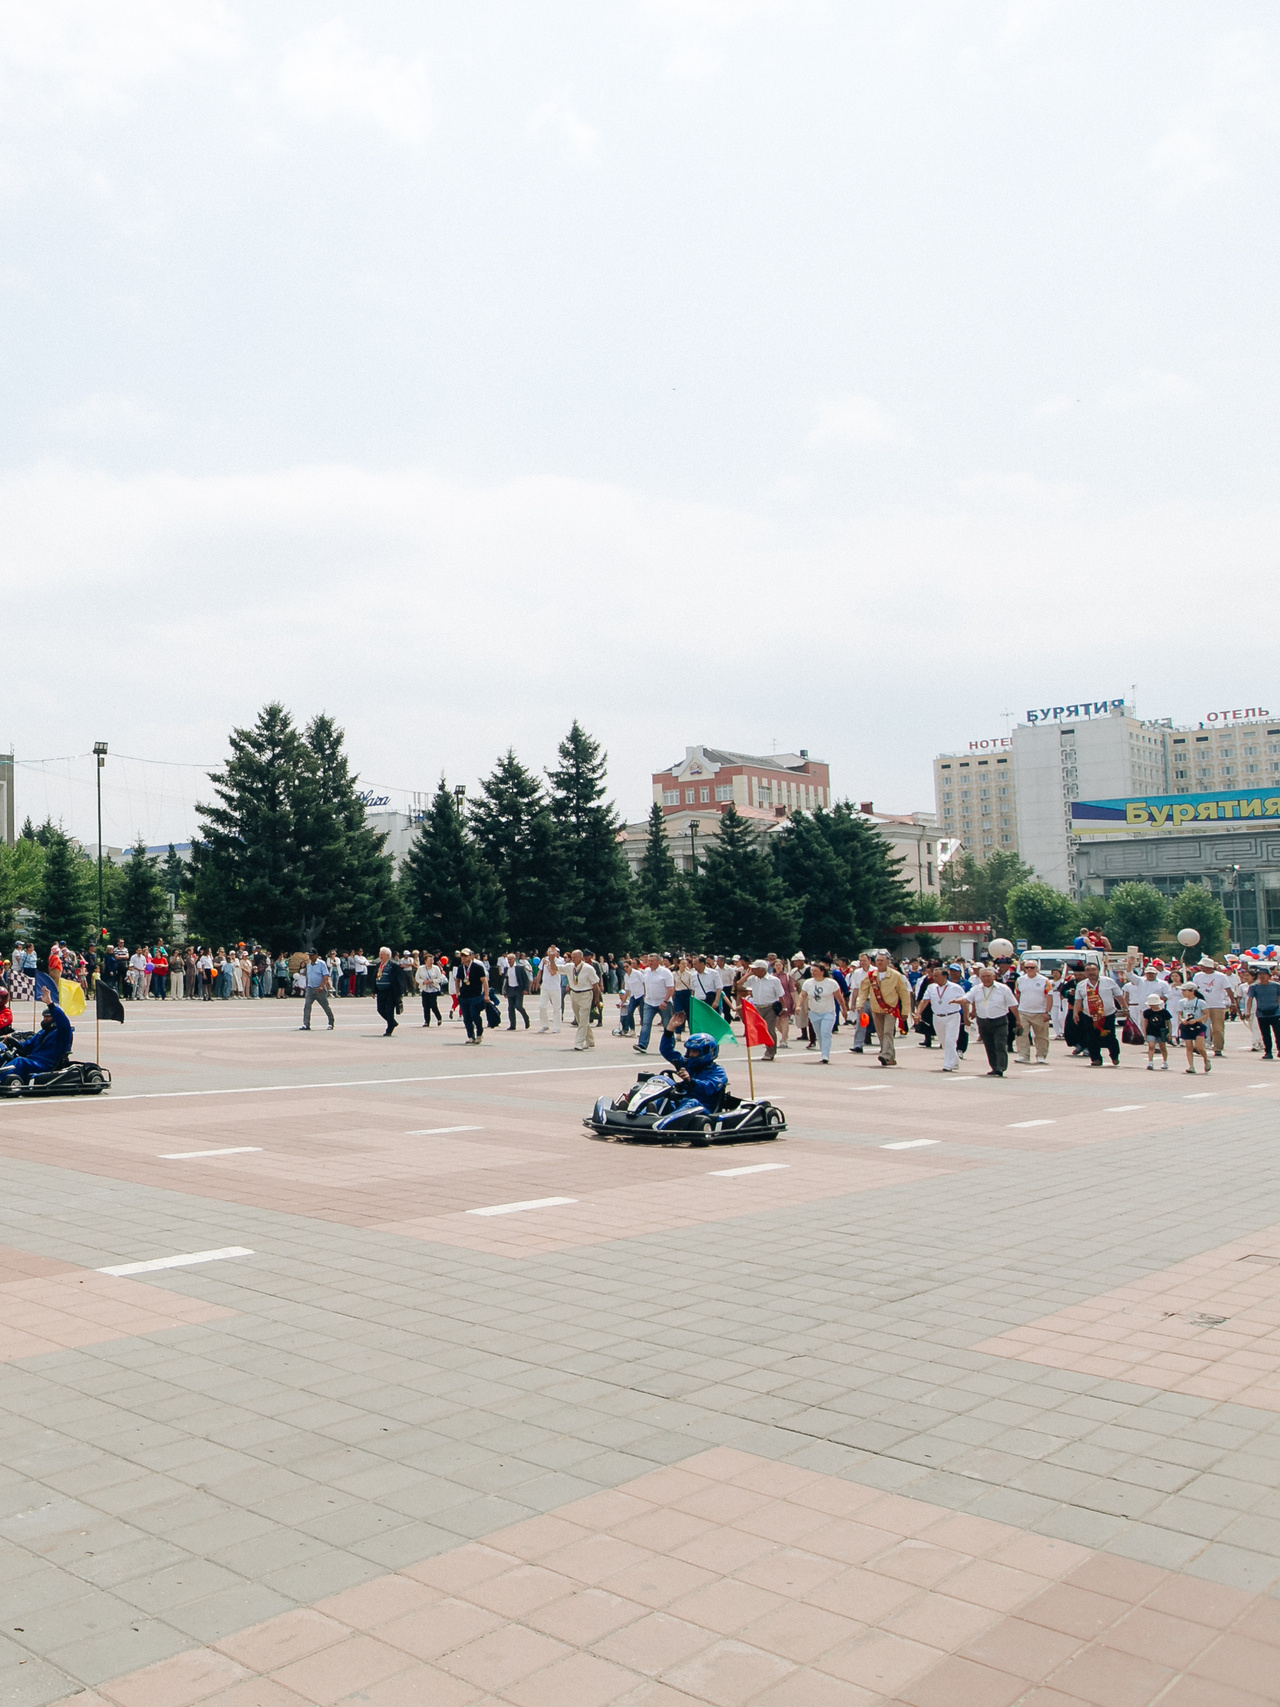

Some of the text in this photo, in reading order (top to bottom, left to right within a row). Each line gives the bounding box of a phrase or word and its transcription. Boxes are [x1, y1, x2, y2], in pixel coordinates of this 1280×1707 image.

[1026, 698, 1125, 722] БУРЯТИЯ
[1206, 707, 1270, 722] ОТЕЛЬ
[1125, 797, 1280, 828] Бурятия
